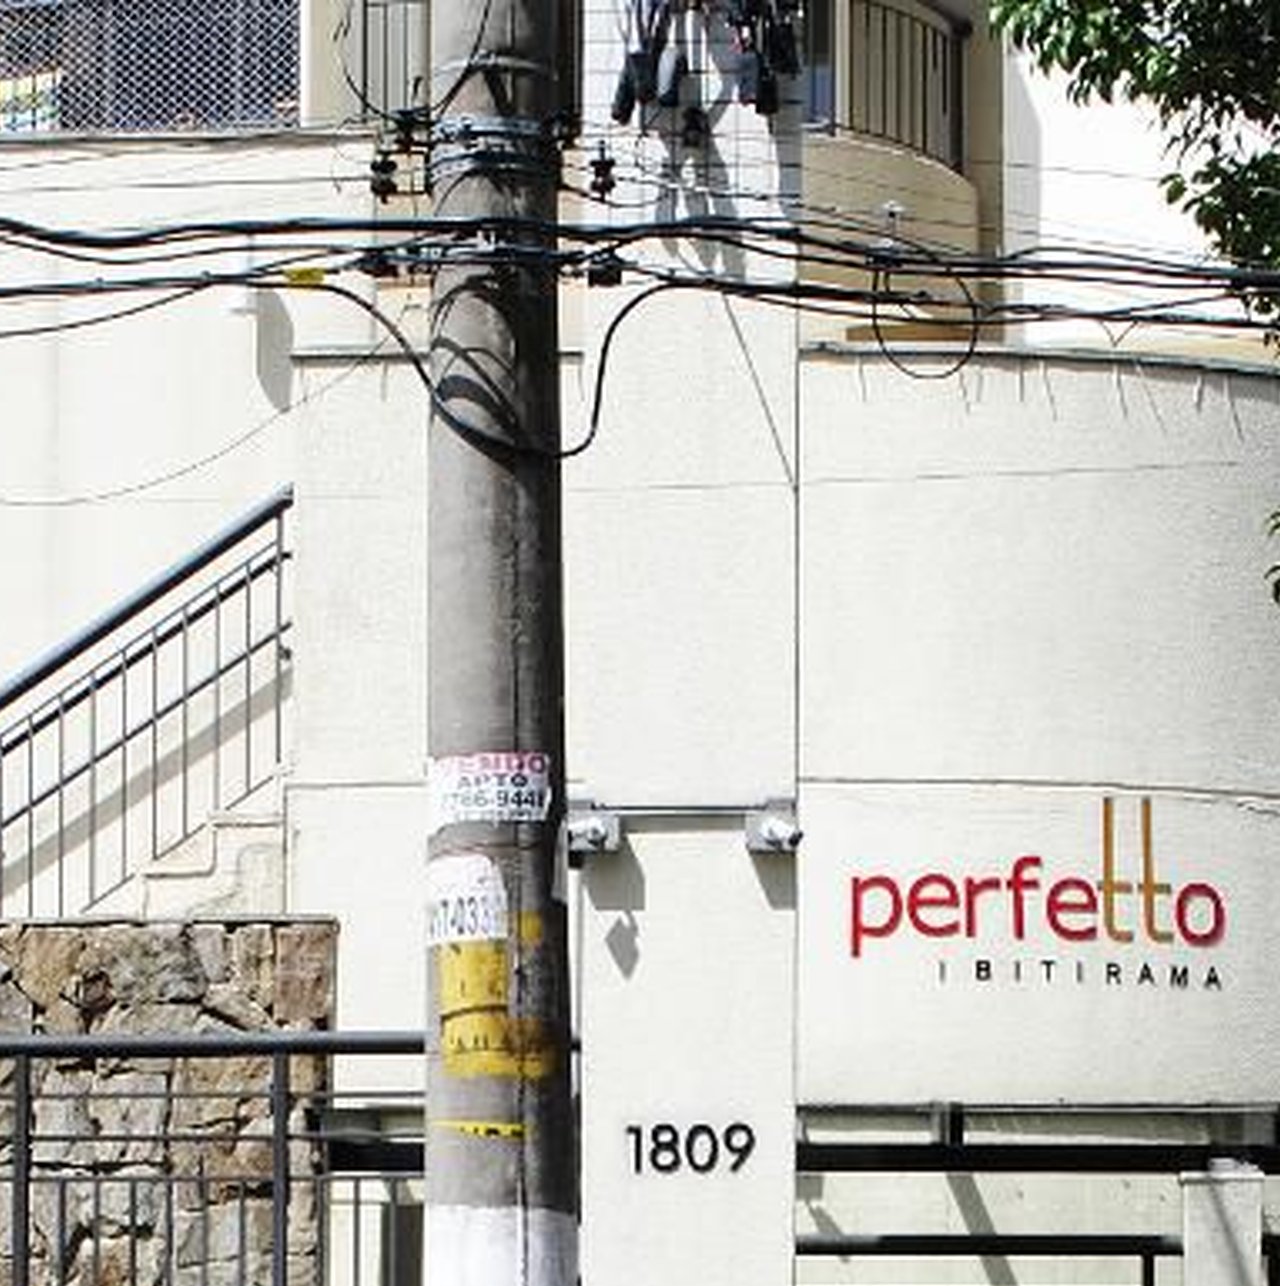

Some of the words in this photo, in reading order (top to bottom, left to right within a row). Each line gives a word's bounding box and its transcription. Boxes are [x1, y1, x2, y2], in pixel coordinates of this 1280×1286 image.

[850, 797, 1225, 957] perfetto
[939, 960, 1221, 989] IBITIRAMA
[626, 1122, 756, 1174] 1809
